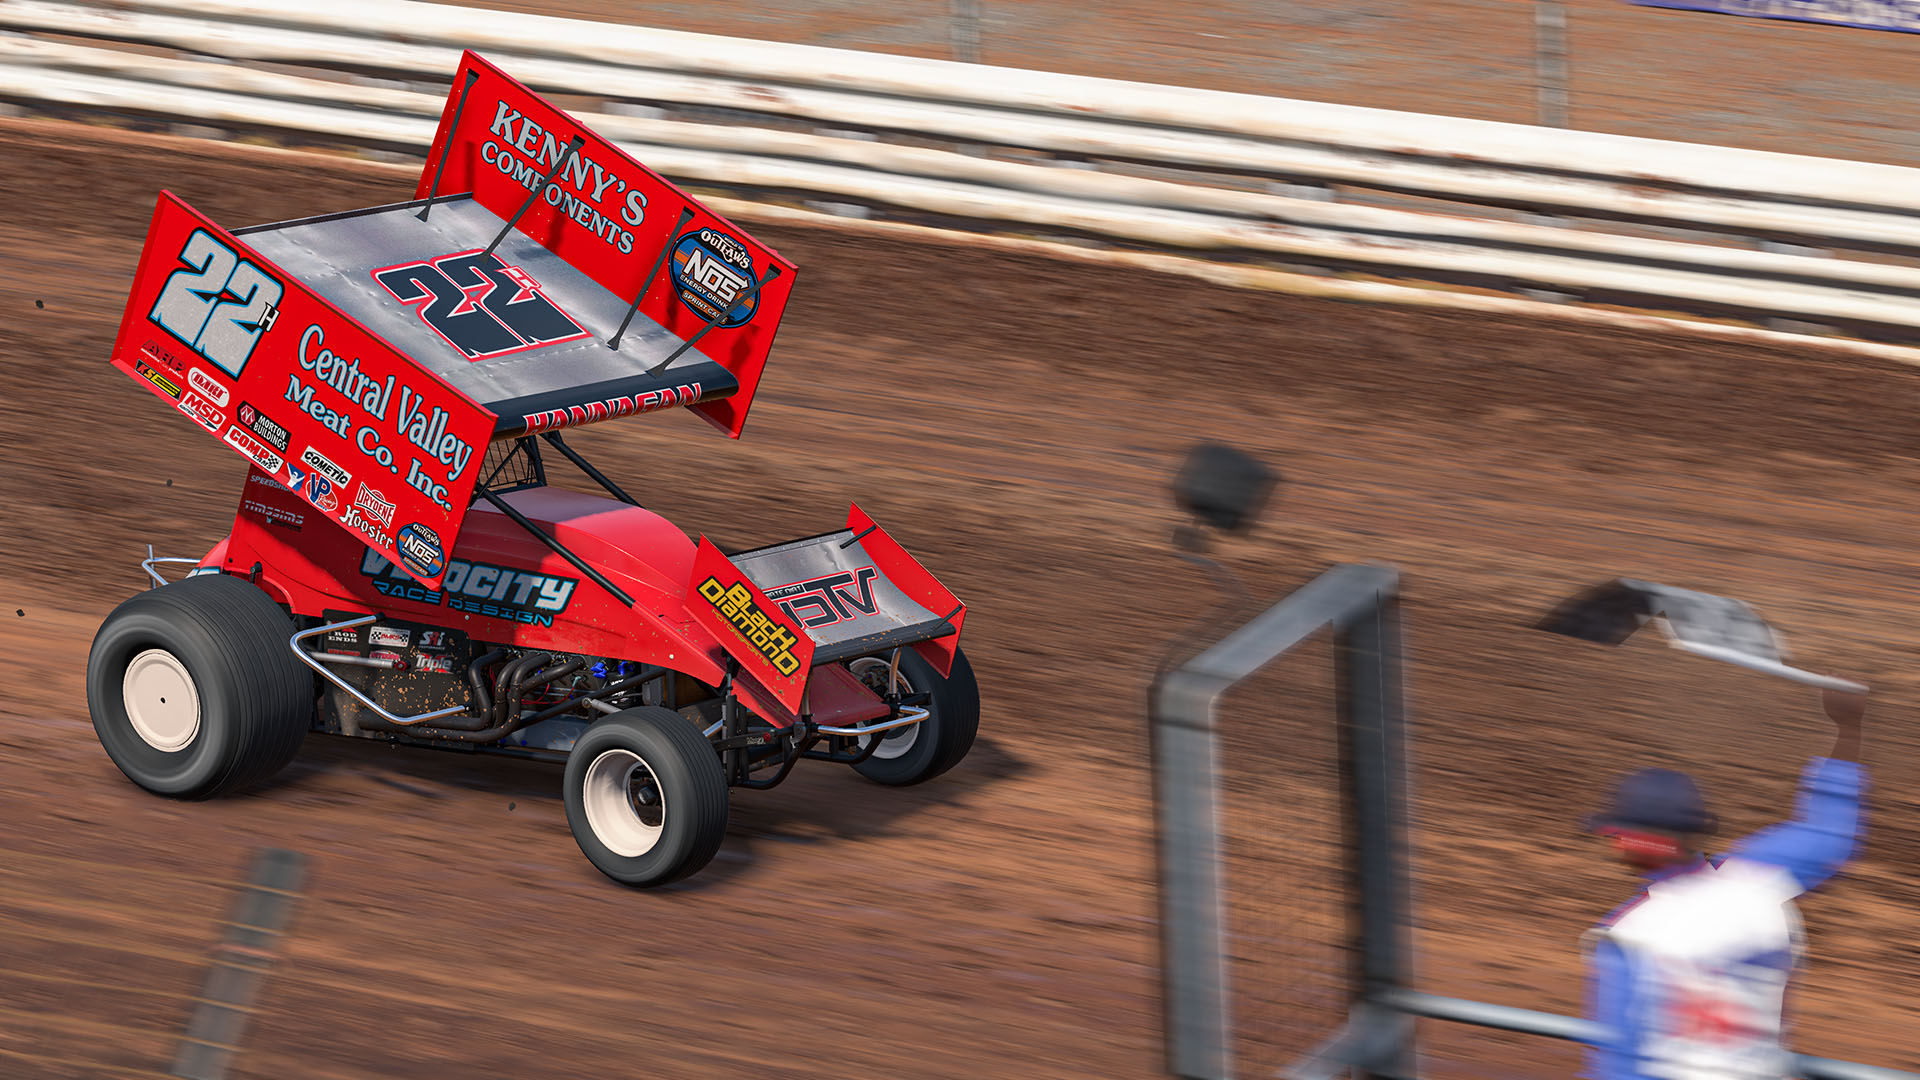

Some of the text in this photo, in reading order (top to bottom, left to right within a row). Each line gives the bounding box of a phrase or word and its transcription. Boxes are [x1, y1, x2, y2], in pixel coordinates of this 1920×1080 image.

[490, 100, 648, 226] KENNY'S
[481, 141, 634, 254] COMPONENTS
[701, 230, 750, 269] OUTLAWS
[679, 274, 729, 309] ENERGY DRINK
[683, 249, 749, 303] NOS
[147, 227, 285, 382] 22
[371, 249, 594, 362] 22
[683, 292, 726, 323] SPRINT CA
[142, 339, 186, 371] ARP
[184, 393, 224, 425] MSD
[298, 324, 473, 482] Central Valley
[523, 383, 702, 436] HANNAGAN
[229, 428, 270, 460] COMP
[253, 422, 287, 451] BUILDINGS
[257, 415, 287, 440] MORTON
[284, 373, 452, 511] Meat Co. Inc.
[252, 454, 272, 470] CAMS
[304, 451, 348, 485] COMETIC
[356, 484, 395, 525] DRYDENE
[338, 504, 393, 550] Hoosier
[403, 534, 439, 564] NOS
[362, 548, 575, 611] VOCITY
[373, 581, 441, 603] RACE
[449, 599, 552, 627] DESIGN
[416, 654, 453, 671] Triple
